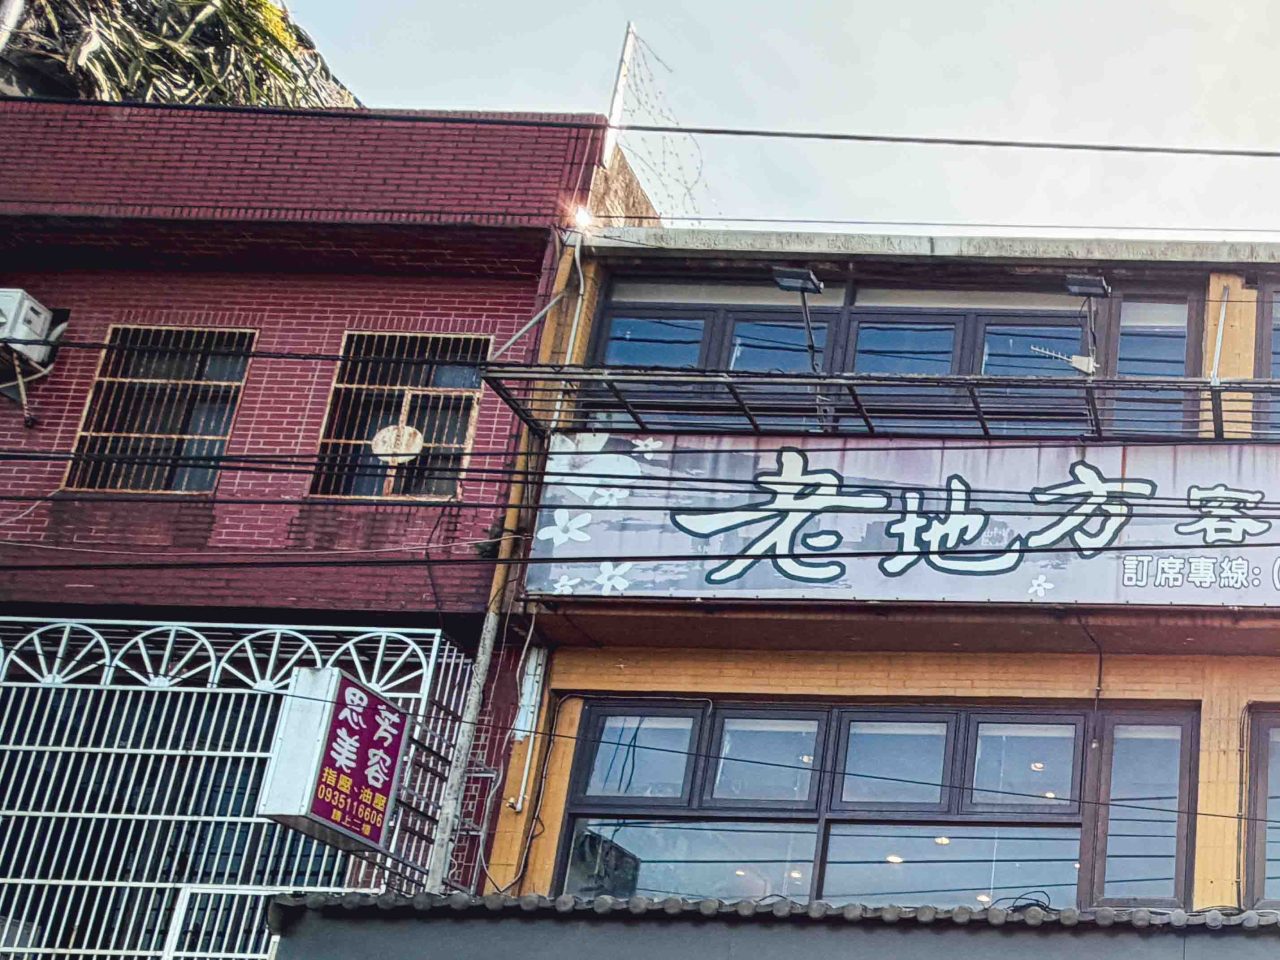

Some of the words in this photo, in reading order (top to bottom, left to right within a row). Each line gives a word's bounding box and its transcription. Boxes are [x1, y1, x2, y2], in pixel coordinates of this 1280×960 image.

[670, 446, 1158, 584] 老地方
[317, 784, 383, 827] 0935116606
